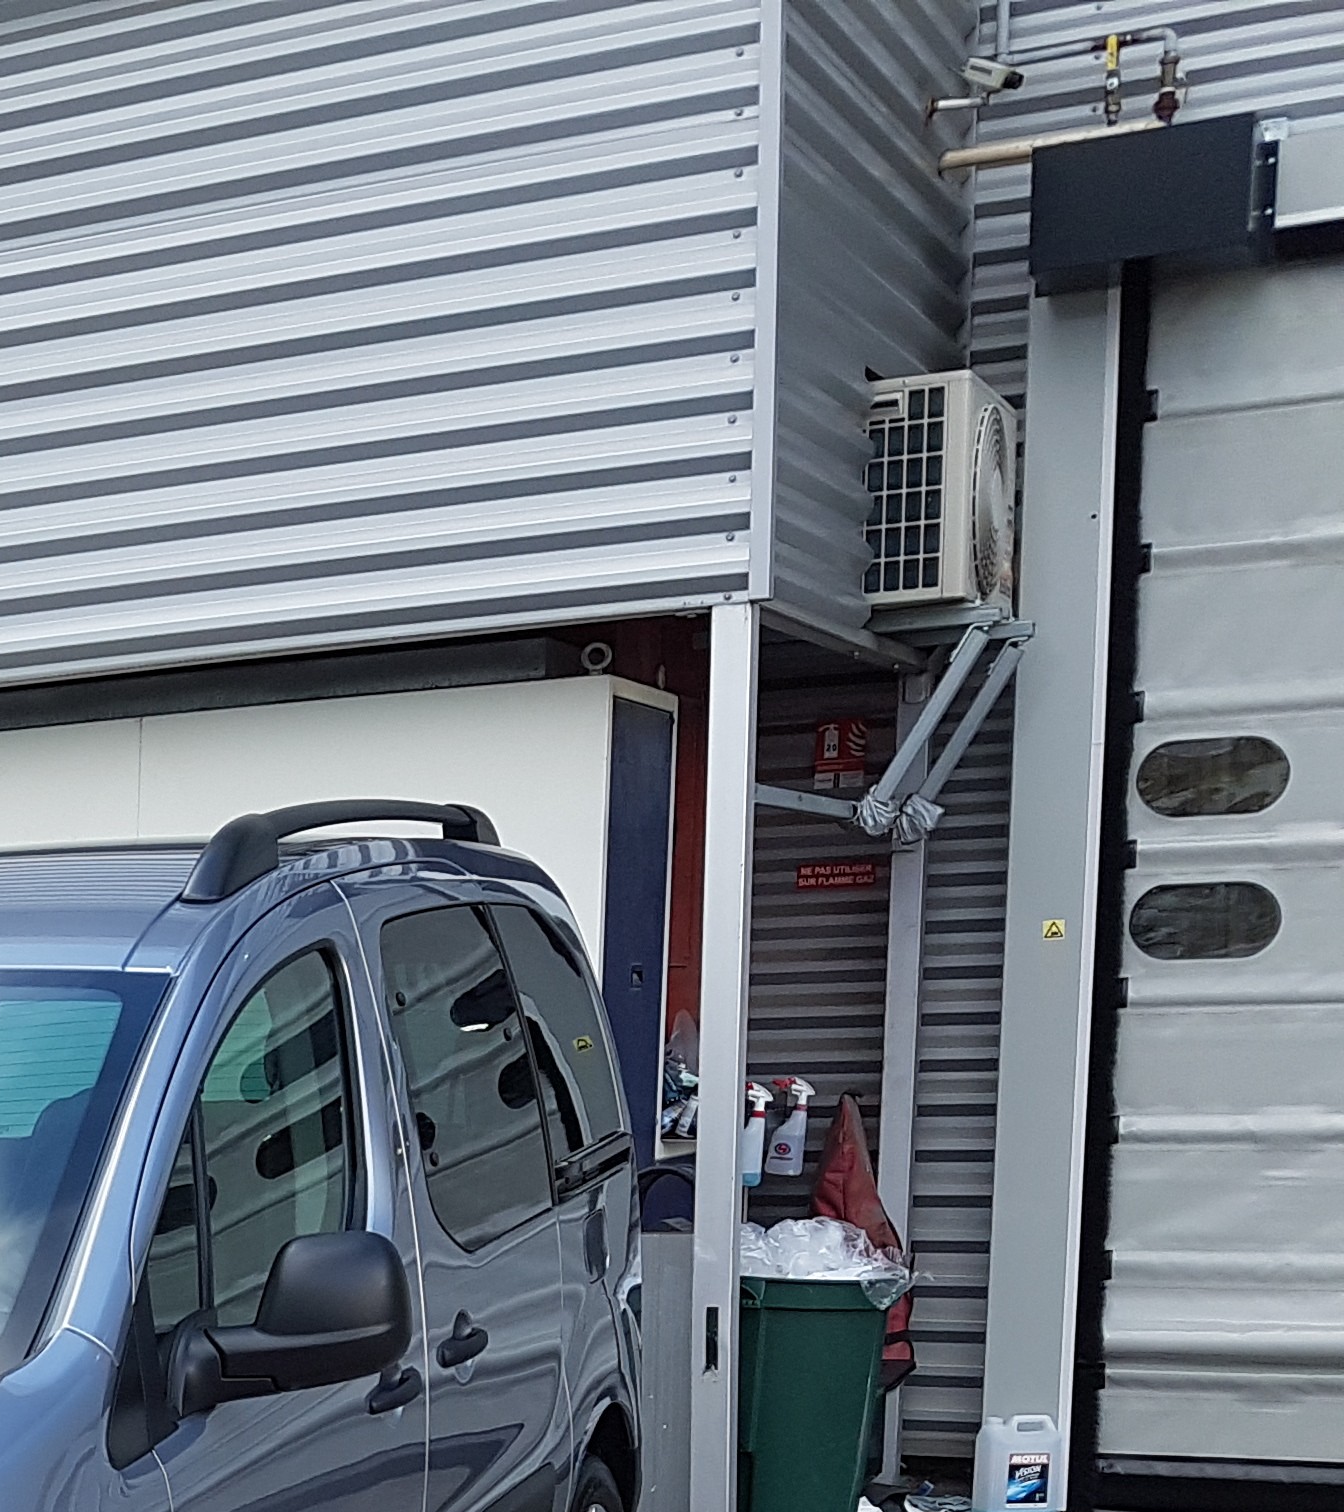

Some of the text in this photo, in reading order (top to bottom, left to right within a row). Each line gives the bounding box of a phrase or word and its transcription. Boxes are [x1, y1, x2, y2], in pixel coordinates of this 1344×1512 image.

[814, 866, 831, 875] PAS
[833, 864, 872, 874] UTILISER
[798, 877, 816, 887] SUR
[1010, 1455, 1049, 1464] MOTUL
